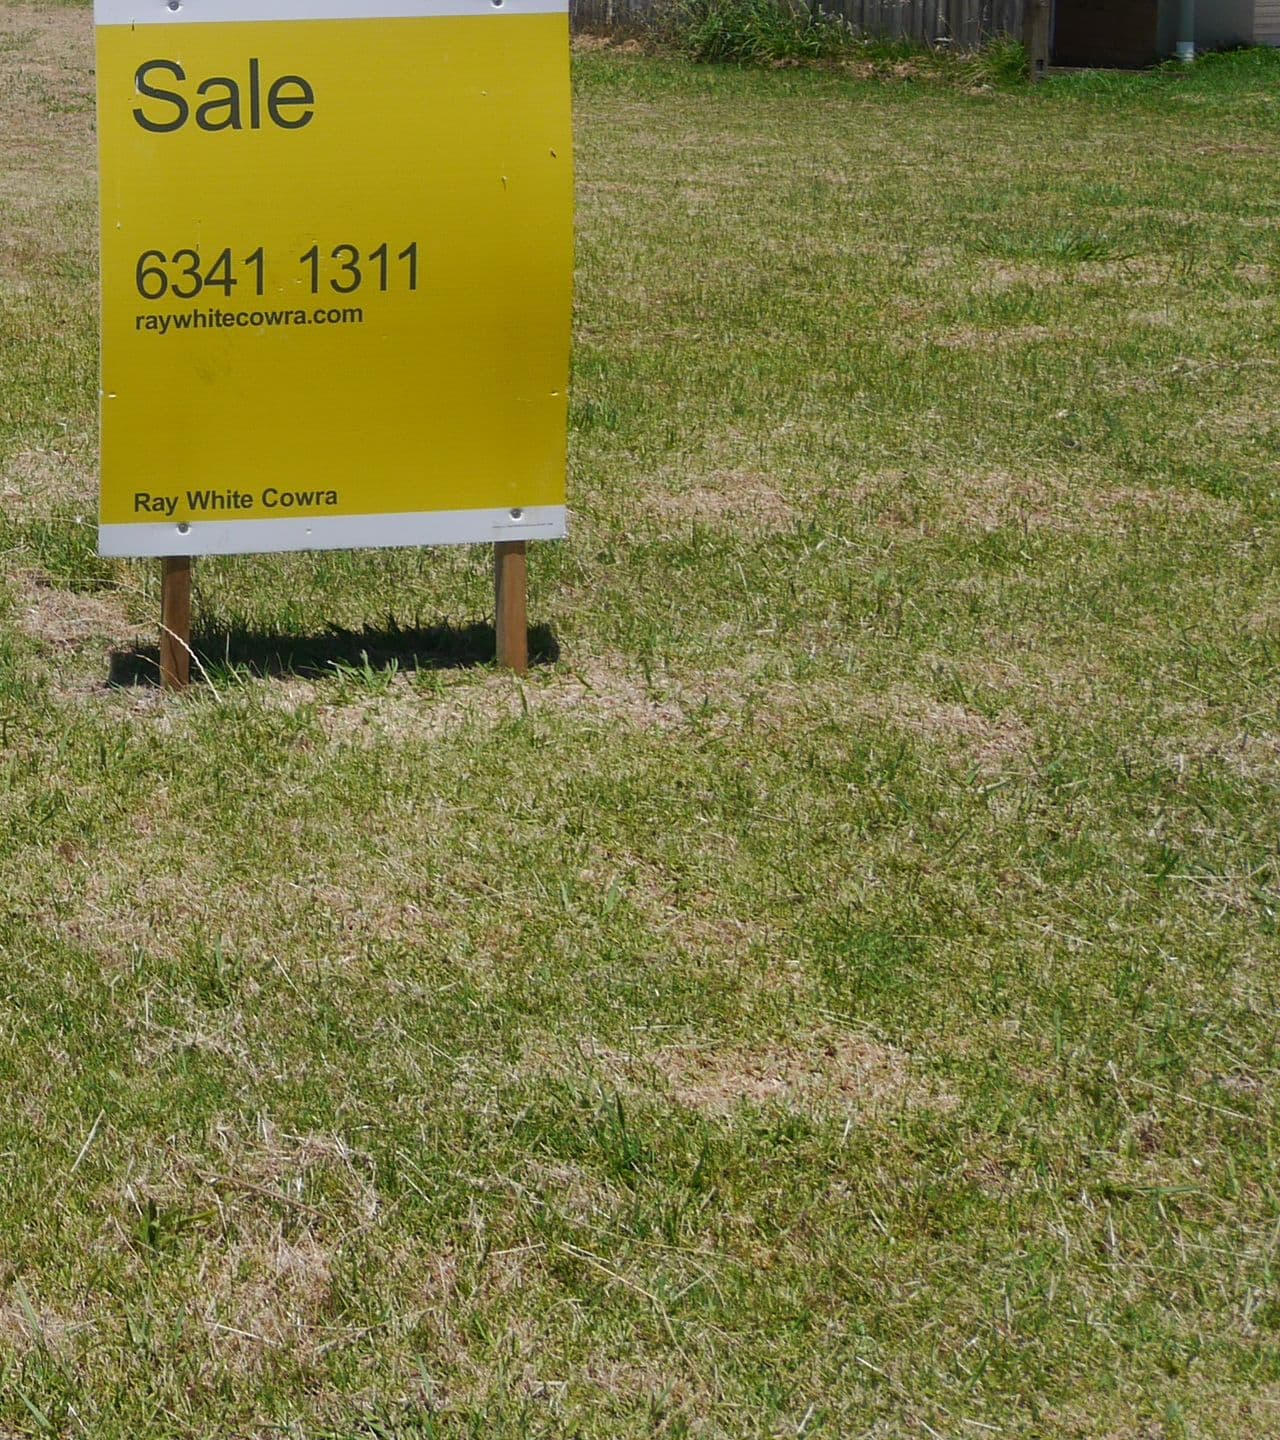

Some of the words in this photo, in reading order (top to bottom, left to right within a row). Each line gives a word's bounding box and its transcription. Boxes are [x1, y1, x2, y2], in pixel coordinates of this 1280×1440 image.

[132, 58, 315, 133] Sale
[135, 247, 264, 300] 6341
[300, 242, 418, 294] 1311
[136, 308, 363, 335] raywhitecowra.com
[134, 492, 179, 517] Ray
[186, 490, 254, 511] White
[261, 487, 338, 508] Cowra
